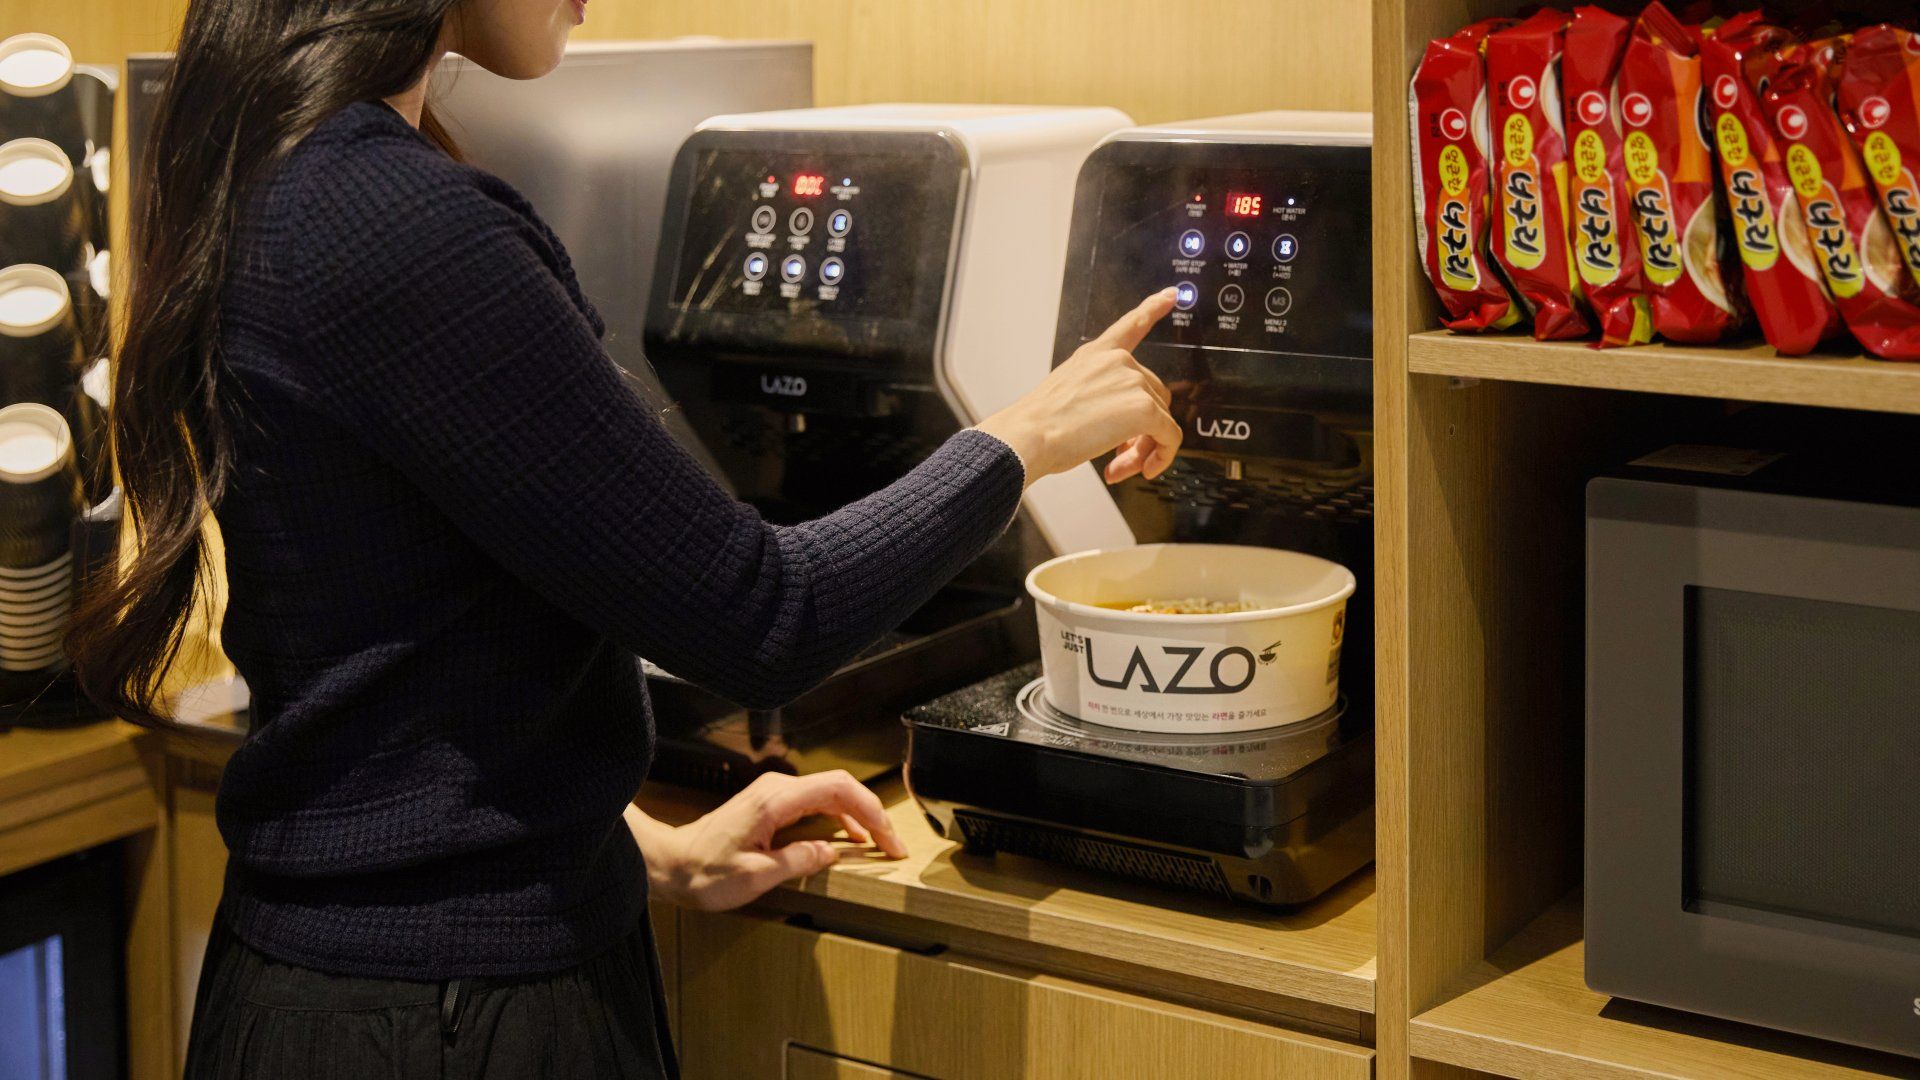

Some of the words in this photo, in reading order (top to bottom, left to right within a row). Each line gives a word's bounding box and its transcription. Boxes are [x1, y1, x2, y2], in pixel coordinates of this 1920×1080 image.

[1509, 118, 1524, 161] 얼큰한
[1582, 134, 1596, 178] 얼큰한
[1633, 135, 1650, 179] 얼큰한
[1445, 149, 1460, 192] 얼큰한
[1508, 172, 1540, 254] 너구리
[1581, 189, 1615, 269] 너구리
[1637, 189, 1678, 269] 너구리
[1732, 170, 1774, 251] 너구리
[1442, 201, 1475, 280] 너구리
[1809, 201, 1857, 280] 너구리
[1224, 294, 1239, 303] M2
[761, 374, 807, 396] LAZO
[1197, 417, 1250, 440] LAZO
[1063, 642, 1084, 654] JUST
[1084, 637, 1256, 695] LAZO
